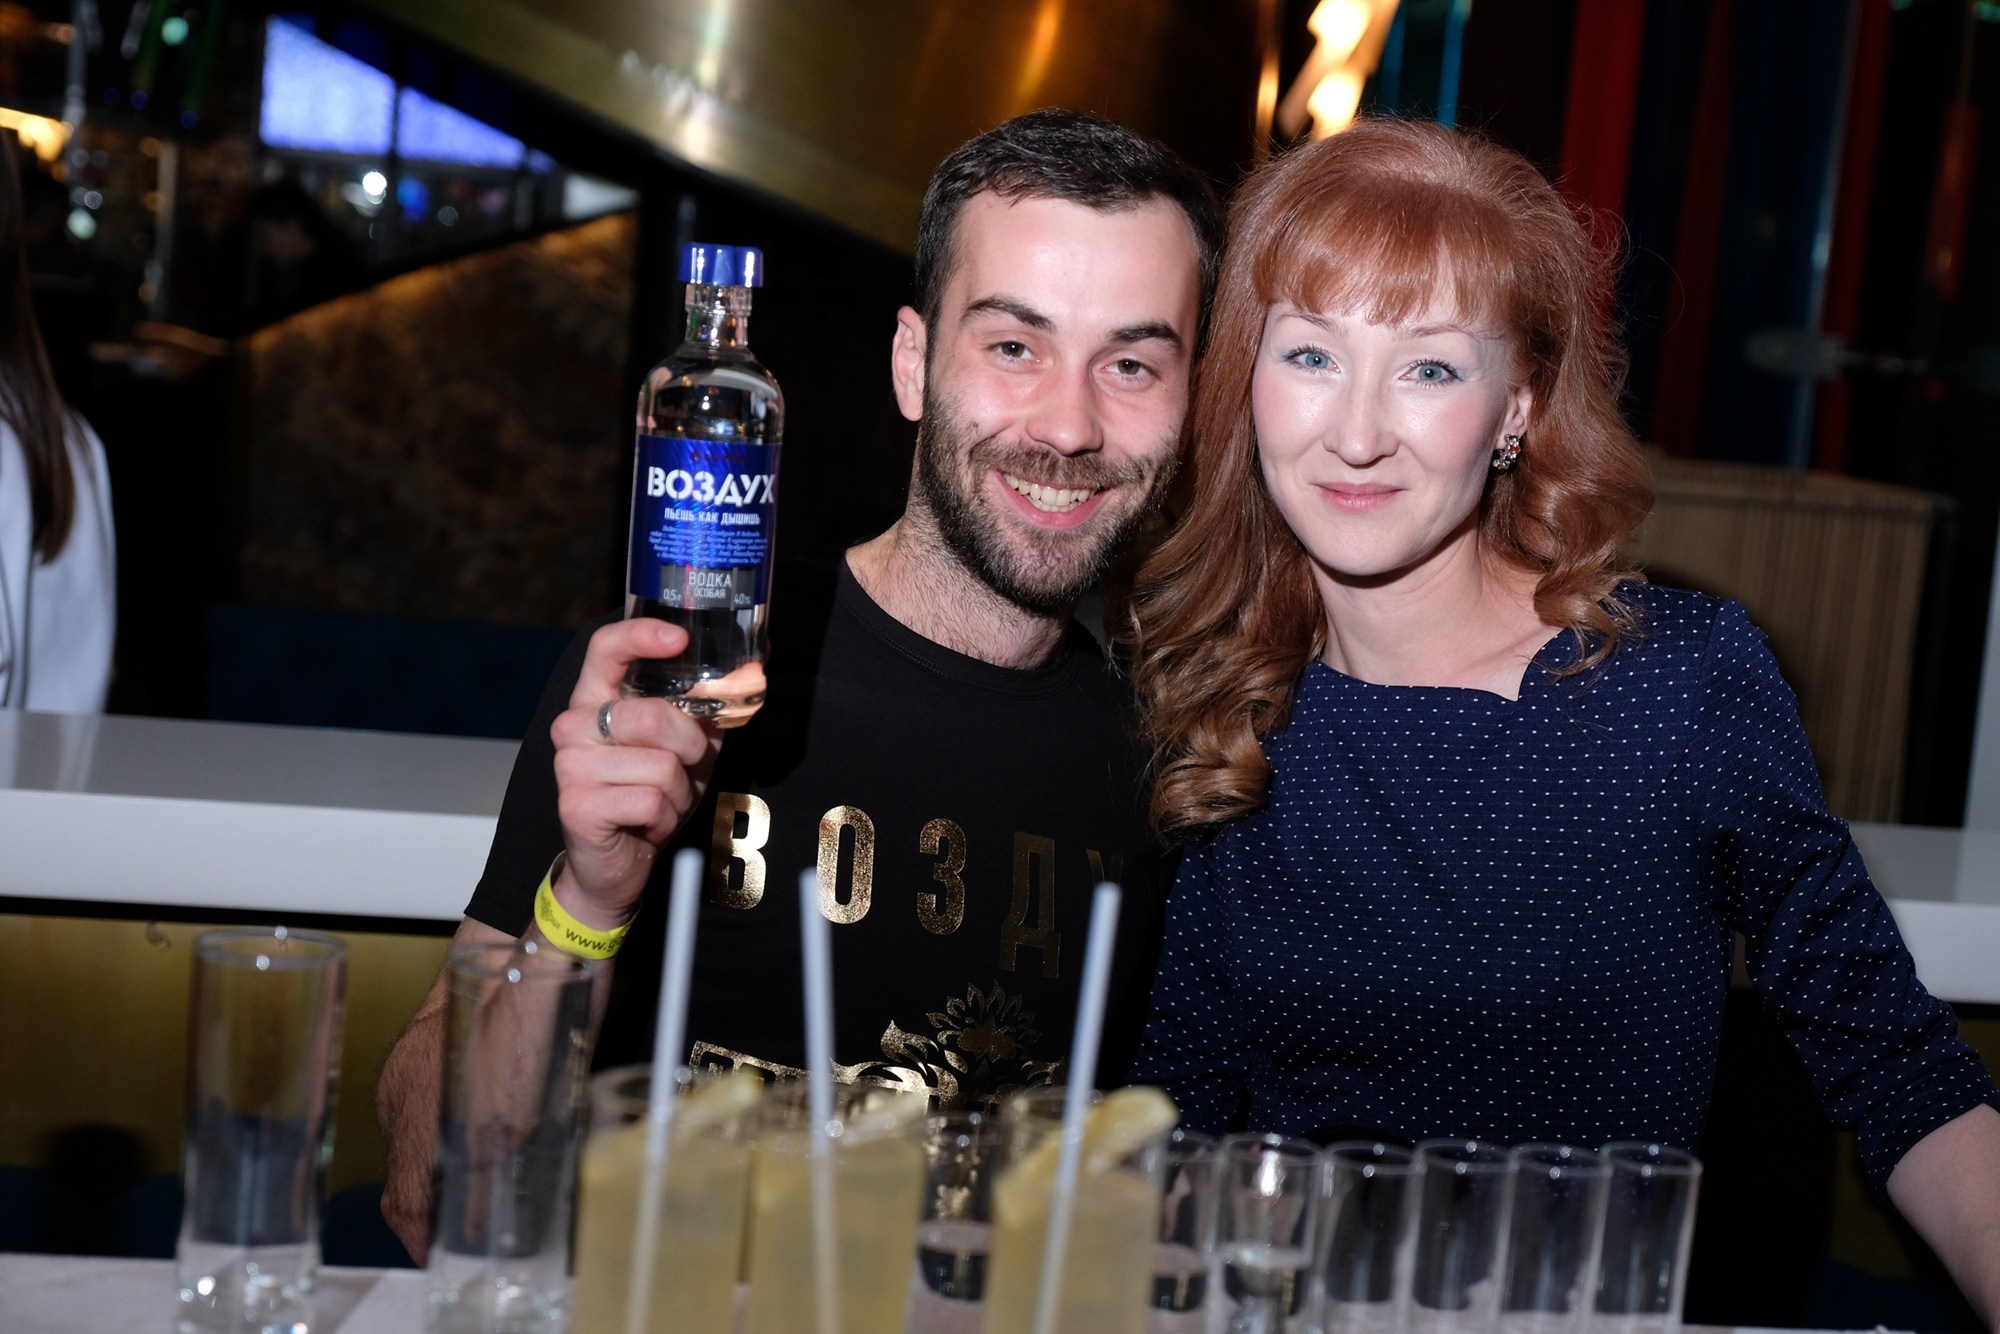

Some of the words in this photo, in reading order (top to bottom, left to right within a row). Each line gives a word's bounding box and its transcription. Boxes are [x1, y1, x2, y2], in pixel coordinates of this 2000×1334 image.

[646, 466, 776, 507] ВОЗДУХ
[664, 507, 694, 522] ПЬЕШЬ
[699, 511, 718, 523] КАК
[720, 512, 761, 526] ДЫШИШЬ
[688, 571, 732, 588] ВОДКА
[693, 587, 727, 598] ОСОБАЯ
